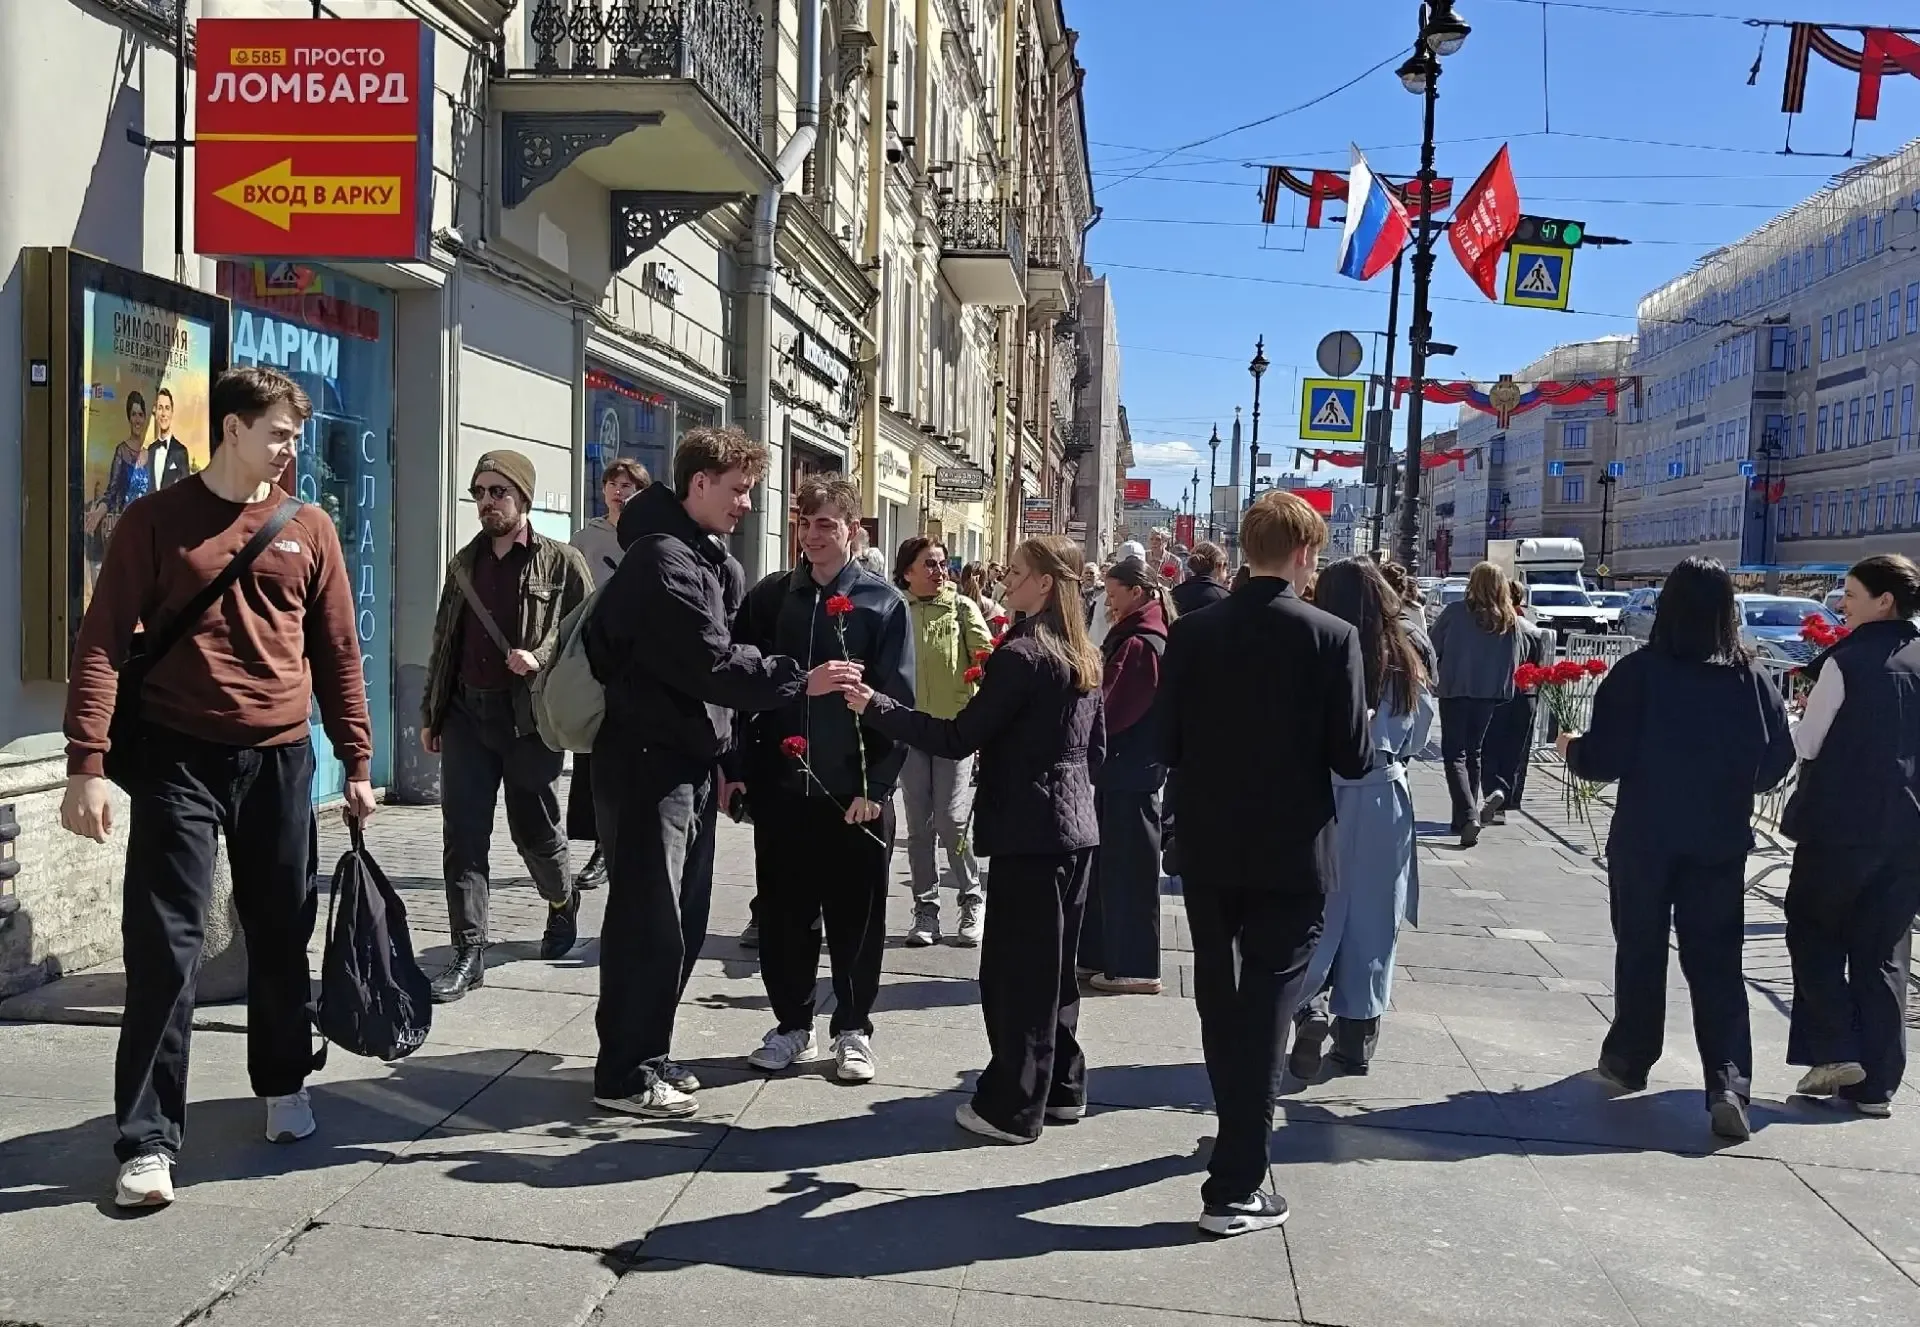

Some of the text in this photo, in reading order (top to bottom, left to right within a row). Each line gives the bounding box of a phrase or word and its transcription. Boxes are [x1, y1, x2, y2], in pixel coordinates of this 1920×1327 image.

[252, 48, 385, 66] 585 ПРОСТО
[207, 72, 409, 104] ЛОМБАРД
[244, 185, 394, 207] ВХОД В АРКУ
[1542, 225, 1557, 240] 47
[113, 311, 188, 351] СИМФОНИЯ
[358, 430, 376, 701] СЛАДОС
